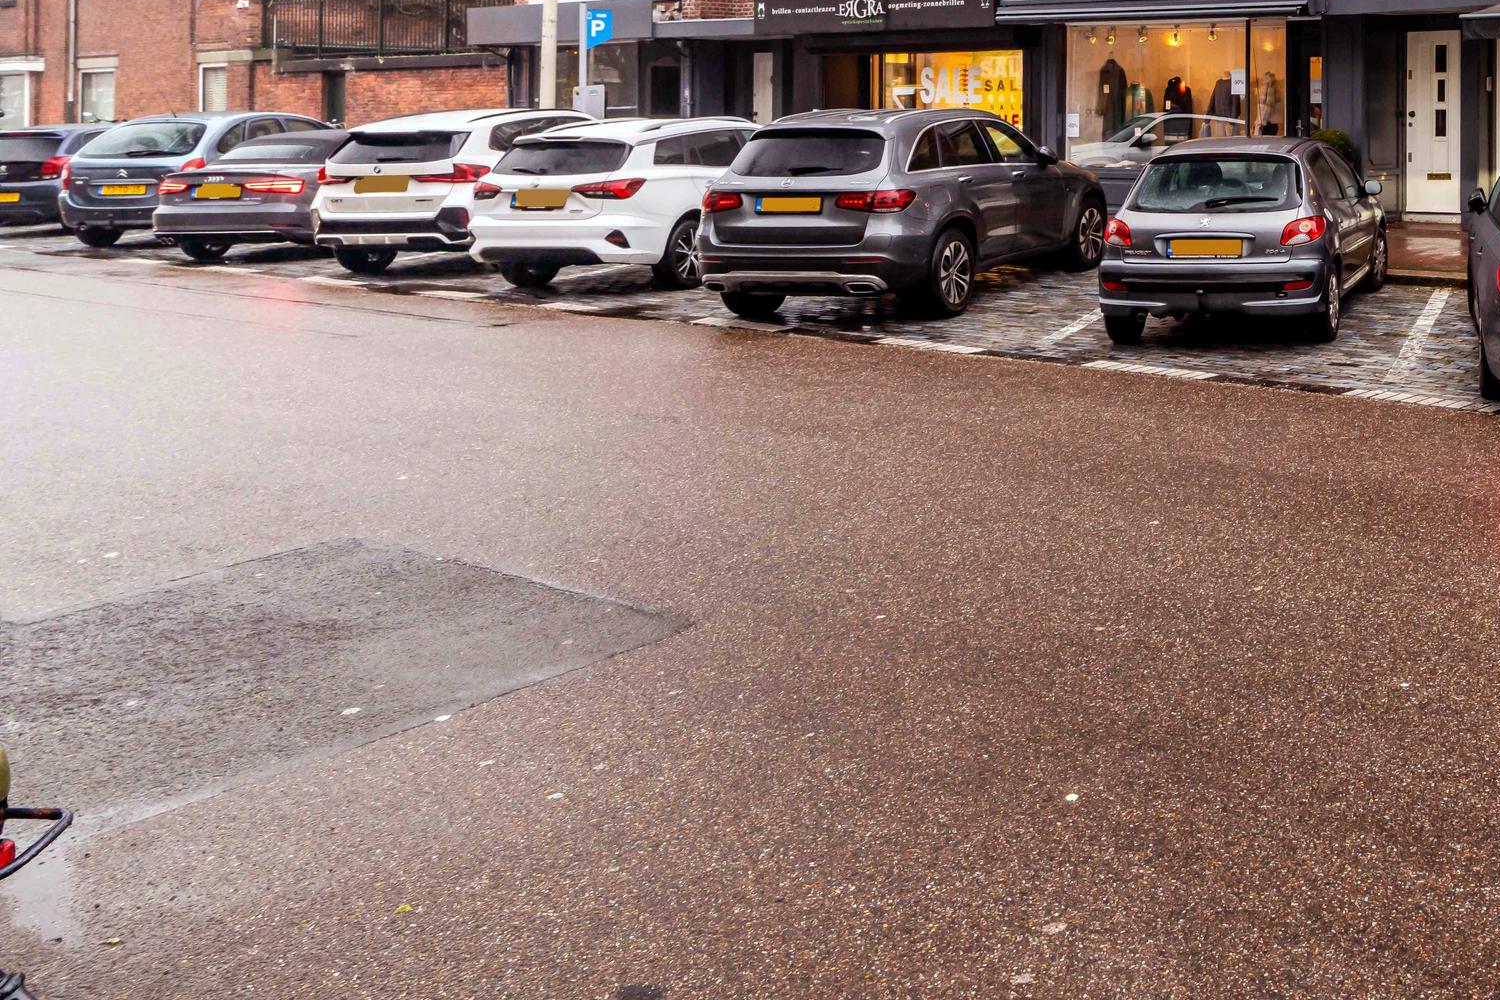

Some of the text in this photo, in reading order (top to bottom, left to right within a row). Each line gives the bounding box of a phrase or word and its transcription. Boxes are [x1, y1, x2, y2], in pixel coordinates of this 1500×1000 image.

[795, 6, 836, 14] contactlenzen
[591, 20, 605, 37] P
[980, 56, 1018, 78] SAL
[920, 66, 982, 104] SALE
[984, 80, 1018, 92] SAL
[987, 95, 1016, 103] SAL
